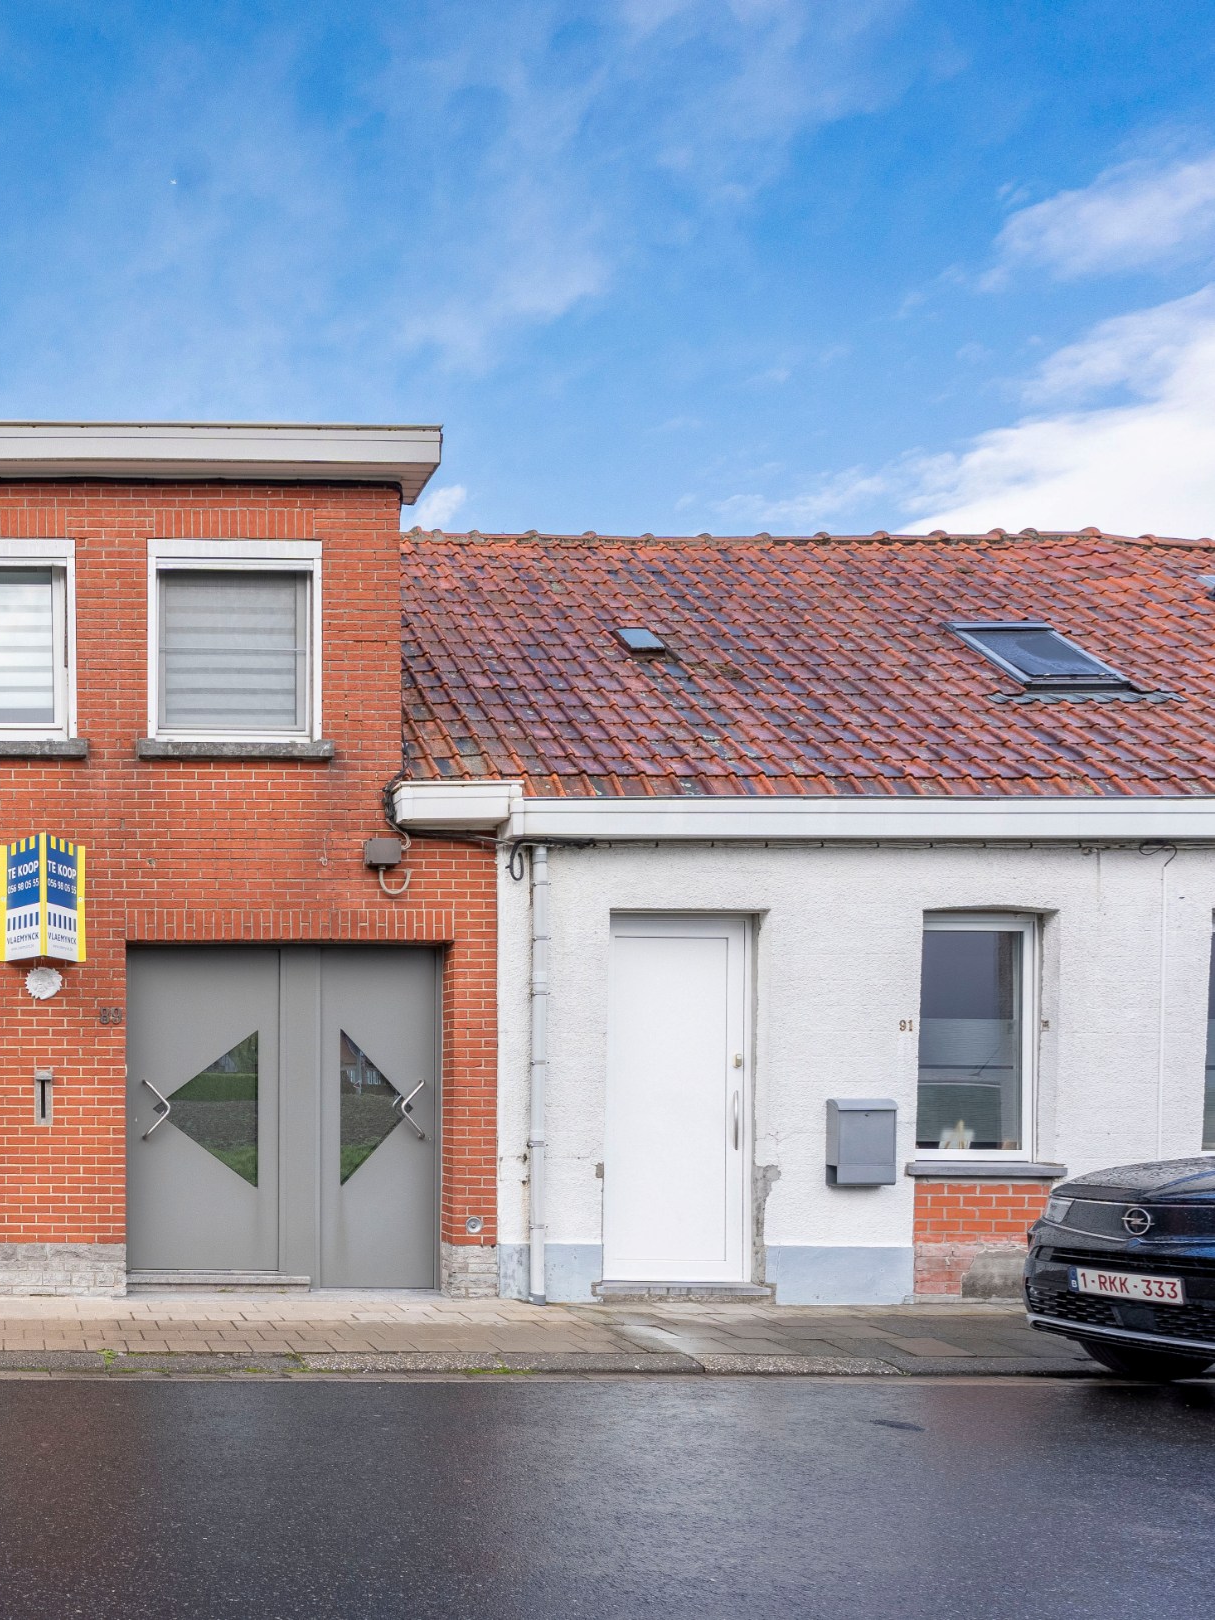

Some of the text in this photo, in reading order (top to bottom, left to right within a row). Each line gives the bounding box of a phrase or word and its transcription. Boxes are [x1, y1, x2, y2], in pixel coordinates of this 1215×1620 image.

[8, 860, 39, 879] TE KOOP
[47, 860, 77, 879] TE KOOP
[8, 884, 17, 894] 056
[33, 878, 39, 887] 55
[47, 878, 57, 888] 056
[7, 932, 39, 945] VLAEMYNCK
[48, 932, 77, 945] VLAEMYNCK
[100, 1007, 122, 1025] 89
[899, 1019, 913, 1032] 91
[1071, 1280, 1077, 1288] B
[1080, 1272, 1178, 1299] 1-RKK-333
